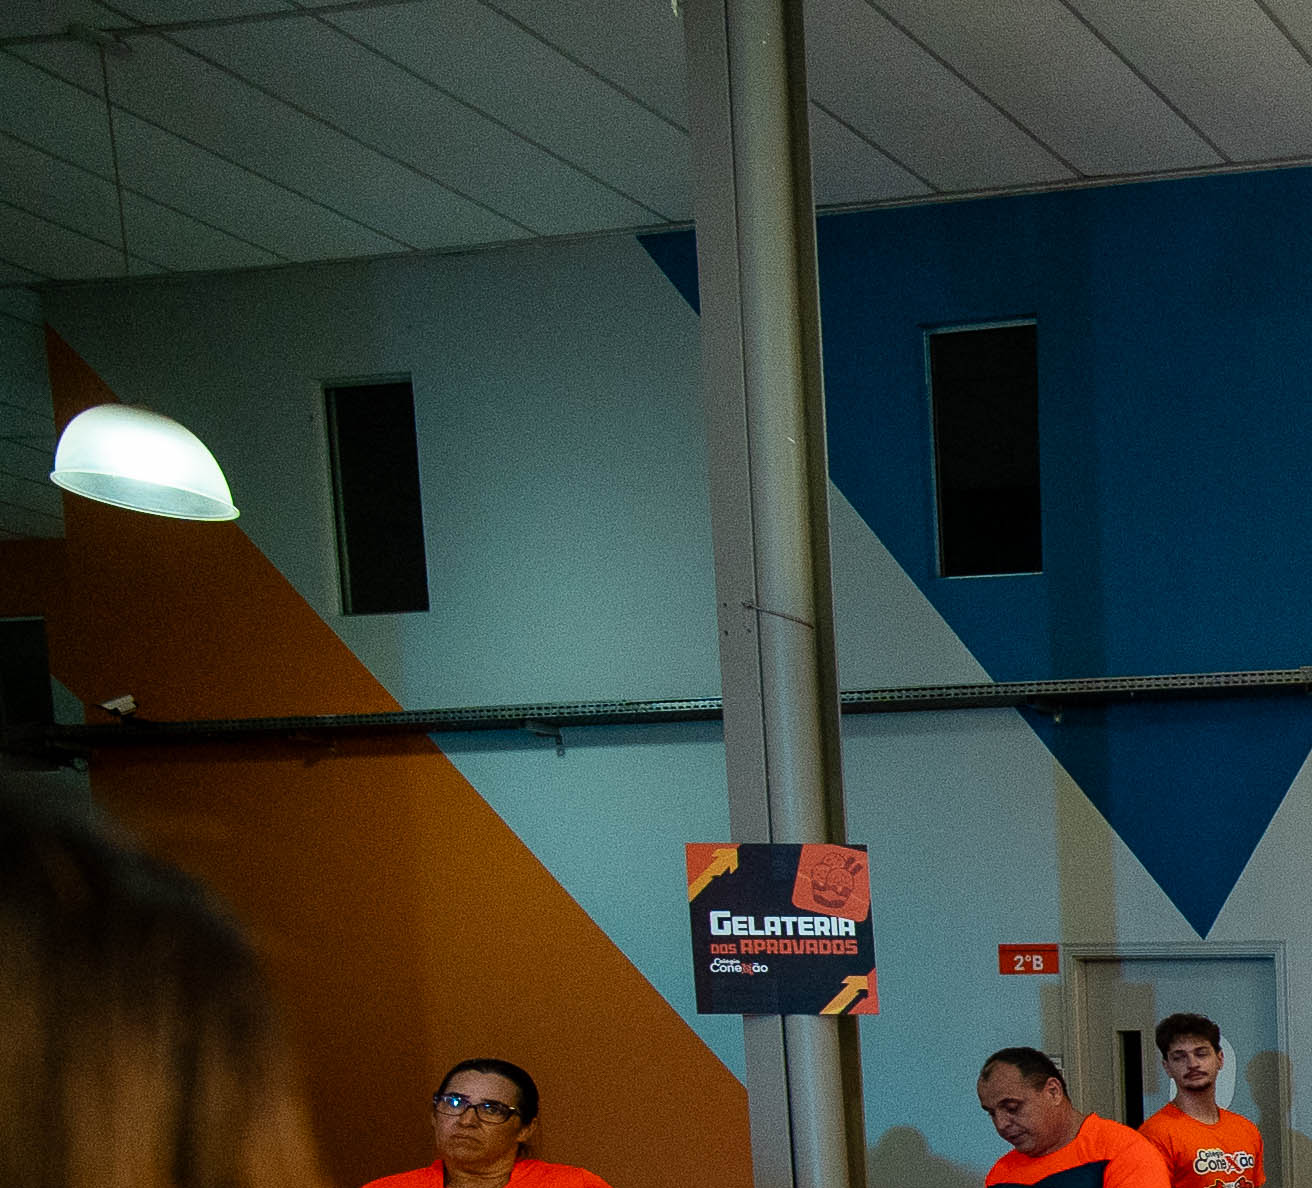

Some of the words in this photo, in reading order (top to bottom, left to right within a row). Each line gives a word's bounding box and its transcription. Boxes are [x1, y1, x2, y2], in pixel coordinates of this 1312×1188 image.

[709, 910, 856, 936] GELATERIA
[710, 943, 737, 955] DOS
[739, 939, 858, 955] APROVADOS
